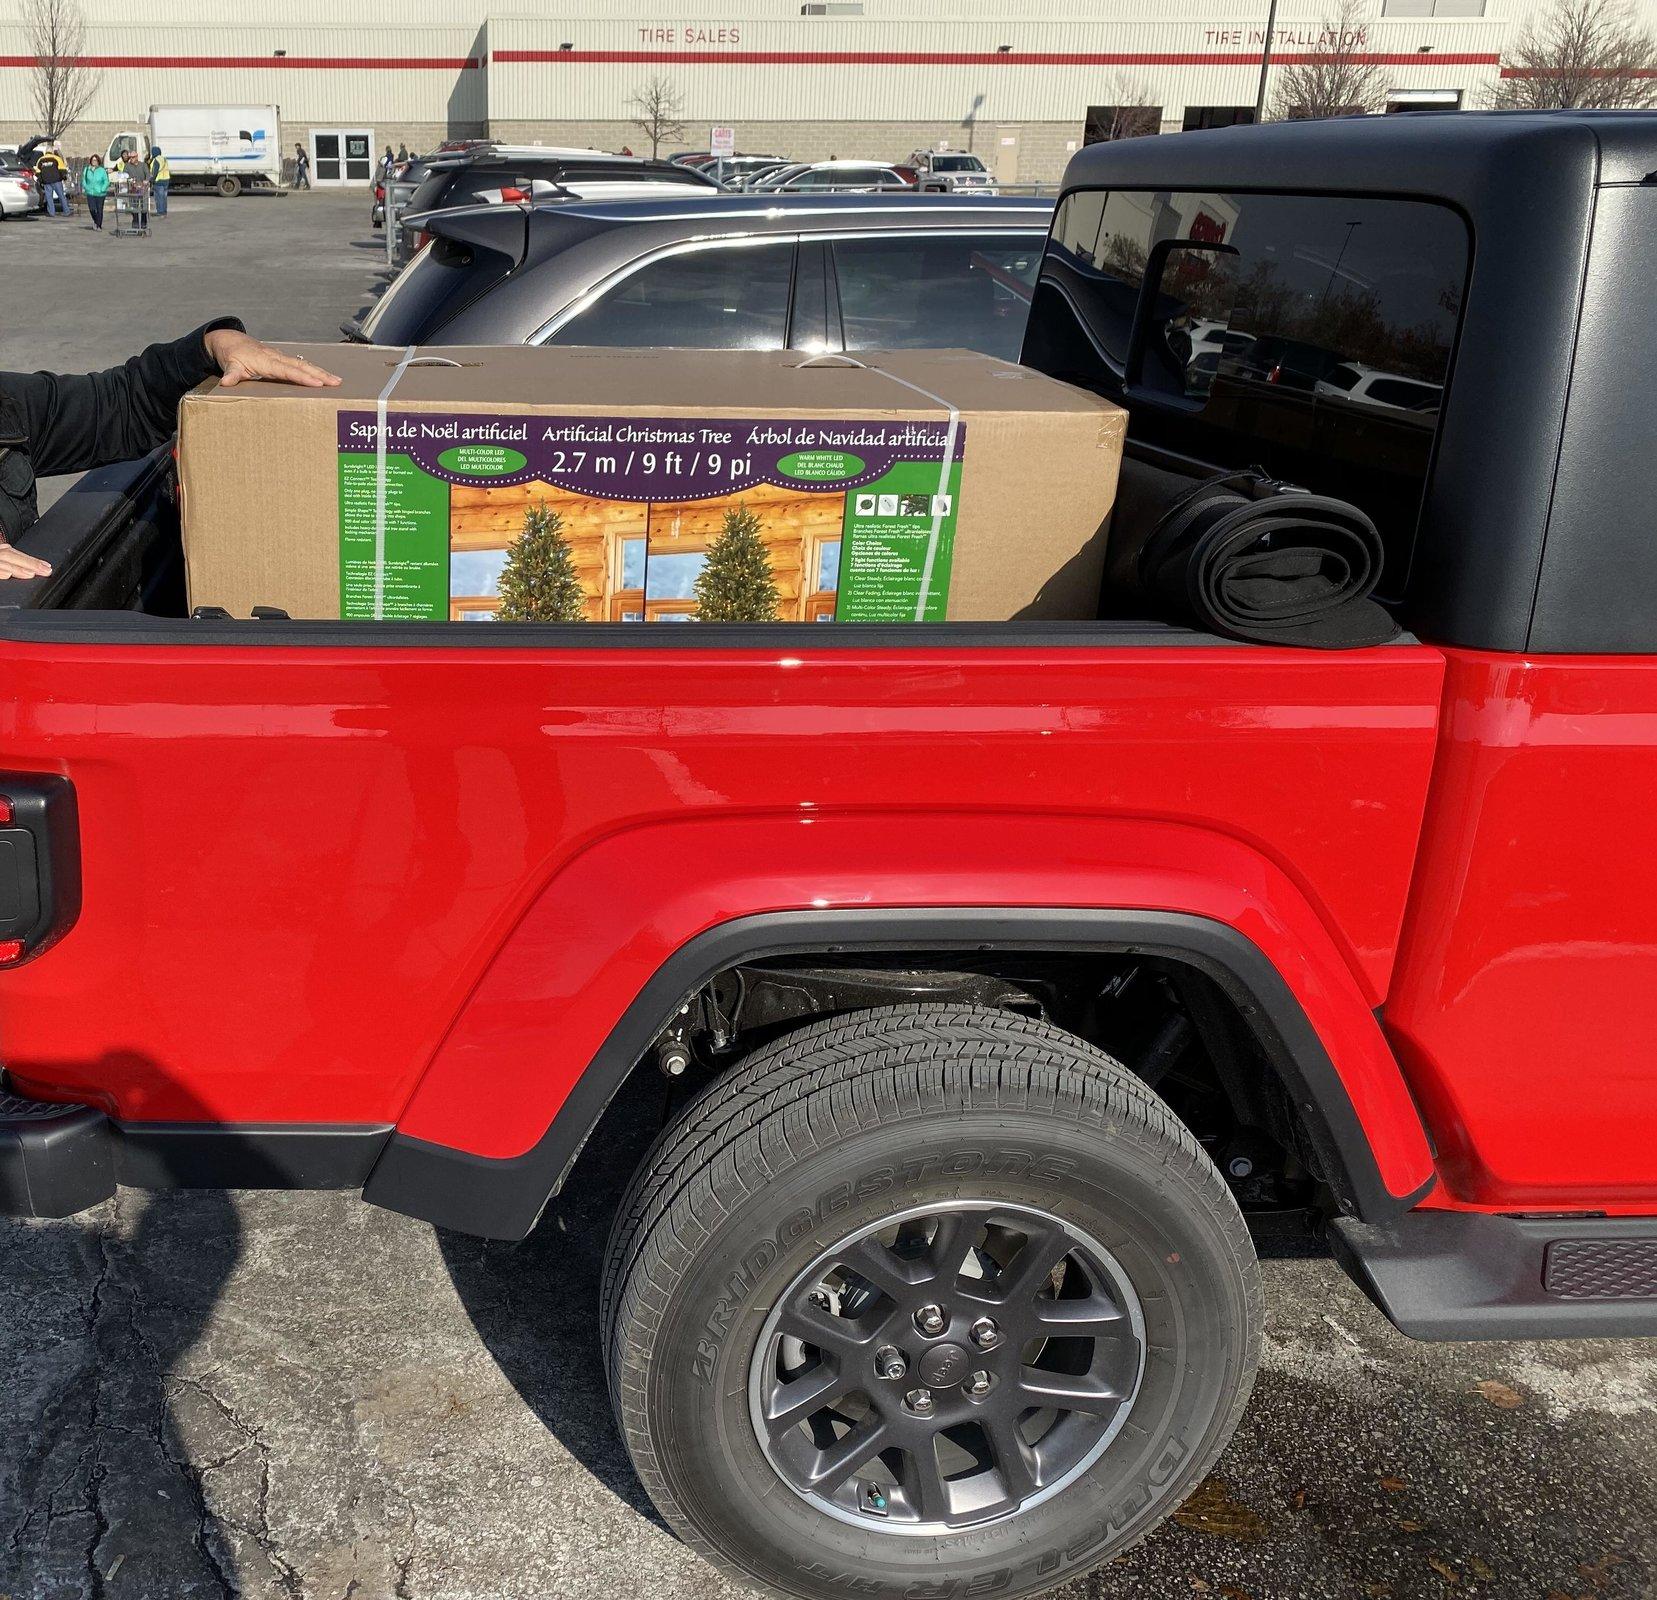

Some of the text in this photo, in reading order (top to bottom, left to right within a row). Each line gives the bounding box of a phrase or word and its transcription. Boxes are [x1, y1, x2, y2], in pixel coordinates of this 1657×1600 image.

[638, 28, 740, 44] TIRE SALES
[1205, 30, 1366, 47] TIRE INTALLATON
[350, 420, 528, 442] Sapn de Noël artificiel
[542, 425, 732, 444] Artificial Christmas Tree
[746, 426, 949, 447] Árbol de Navidad artificia
[459, 448, 494, 456] MULTI-COLOR
[552, 451, 751, 480] 2.7 m / 9 ft / 9 pi
[692, 1149, 1079, 1387] BRIDGESTONE
[932, 1349, 959, 1382] Jeep
